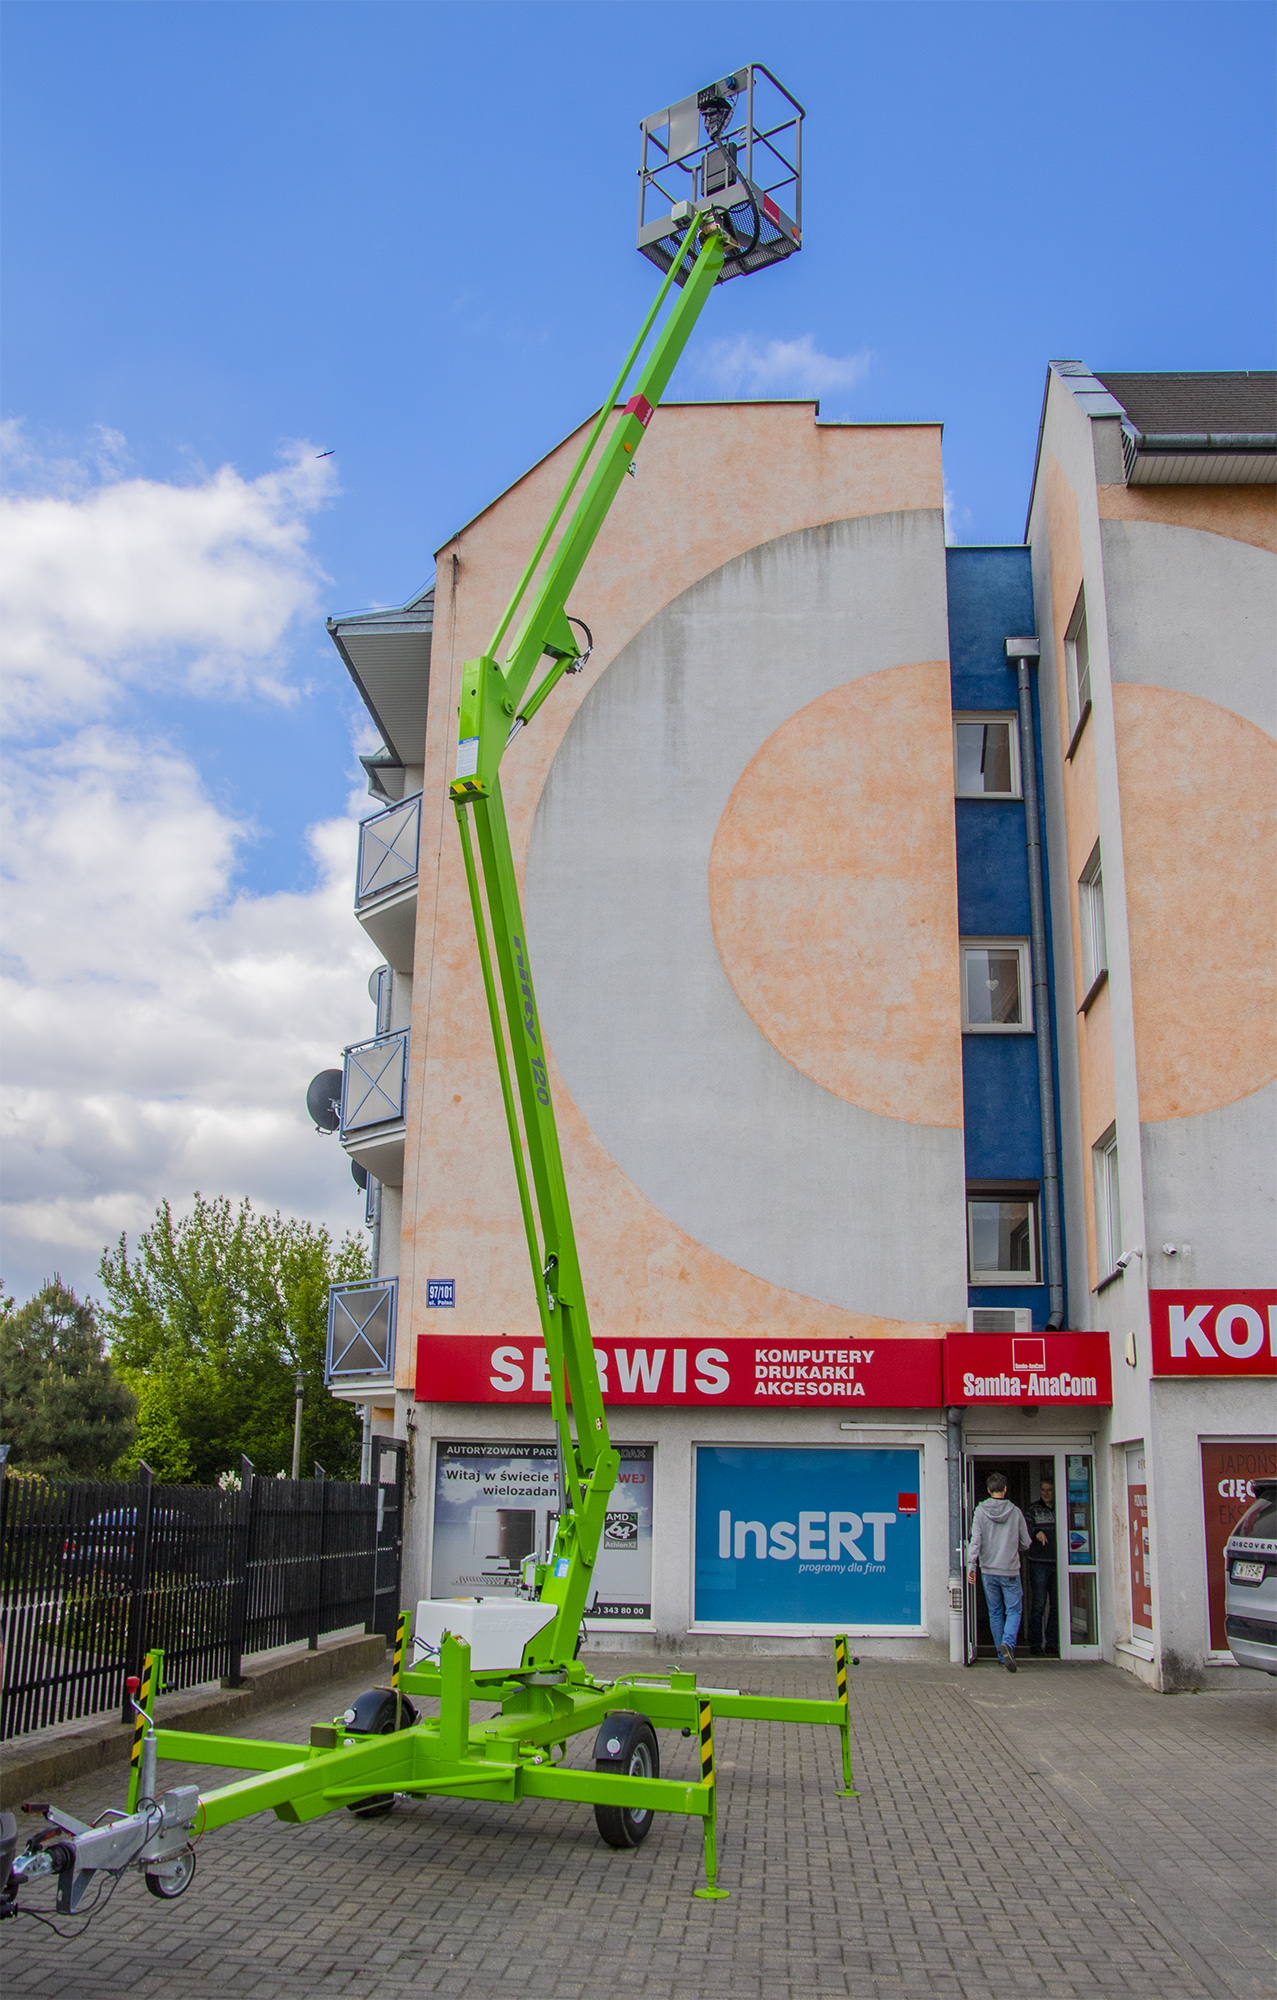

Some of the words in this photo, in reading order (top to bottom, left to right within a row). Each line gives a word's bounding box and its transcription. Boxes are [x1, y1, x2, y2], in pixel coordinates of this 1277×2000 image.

[531, 1056, 550, 1106] 120
[429, 1285, 452, 1299] 97/101
[755, 1349, 875, 1363] KOMPUTERY
[755, 1365, 855, 1379] DRUKARKI
[754, 1381, 866, 1396] AKCESORIA
[963, 1372, 1097, 1397] Samba-AnaCom
[447, 1446, 530, 1456] AUTORYZOWANY
[533, 1448, 558, 1456] PART
[446, 1470, 480, 1483] Witaj
[485, 1472, 496, 1481] w
[500, 1470, 549, 1482] świecie
[483, 1485, 559, 1496] wielozadan
[606, 1513, 629, 1521] AMD
[1219, 1505, 1251, 1524] EKS
[611, 1521, 631, 1539] 64
[719, 1510, 896, 1562] InsERT
[1232, 1541, 1277, 1550] DISCOVERY
[798, 1564, 845, 1574] programy
[847, 1562, 863, 1573] dla
[863, 1562, 886, 1575] firm
[621, 1607, 631, 1615] 80
[633, 1607, 644, 1615] 00
